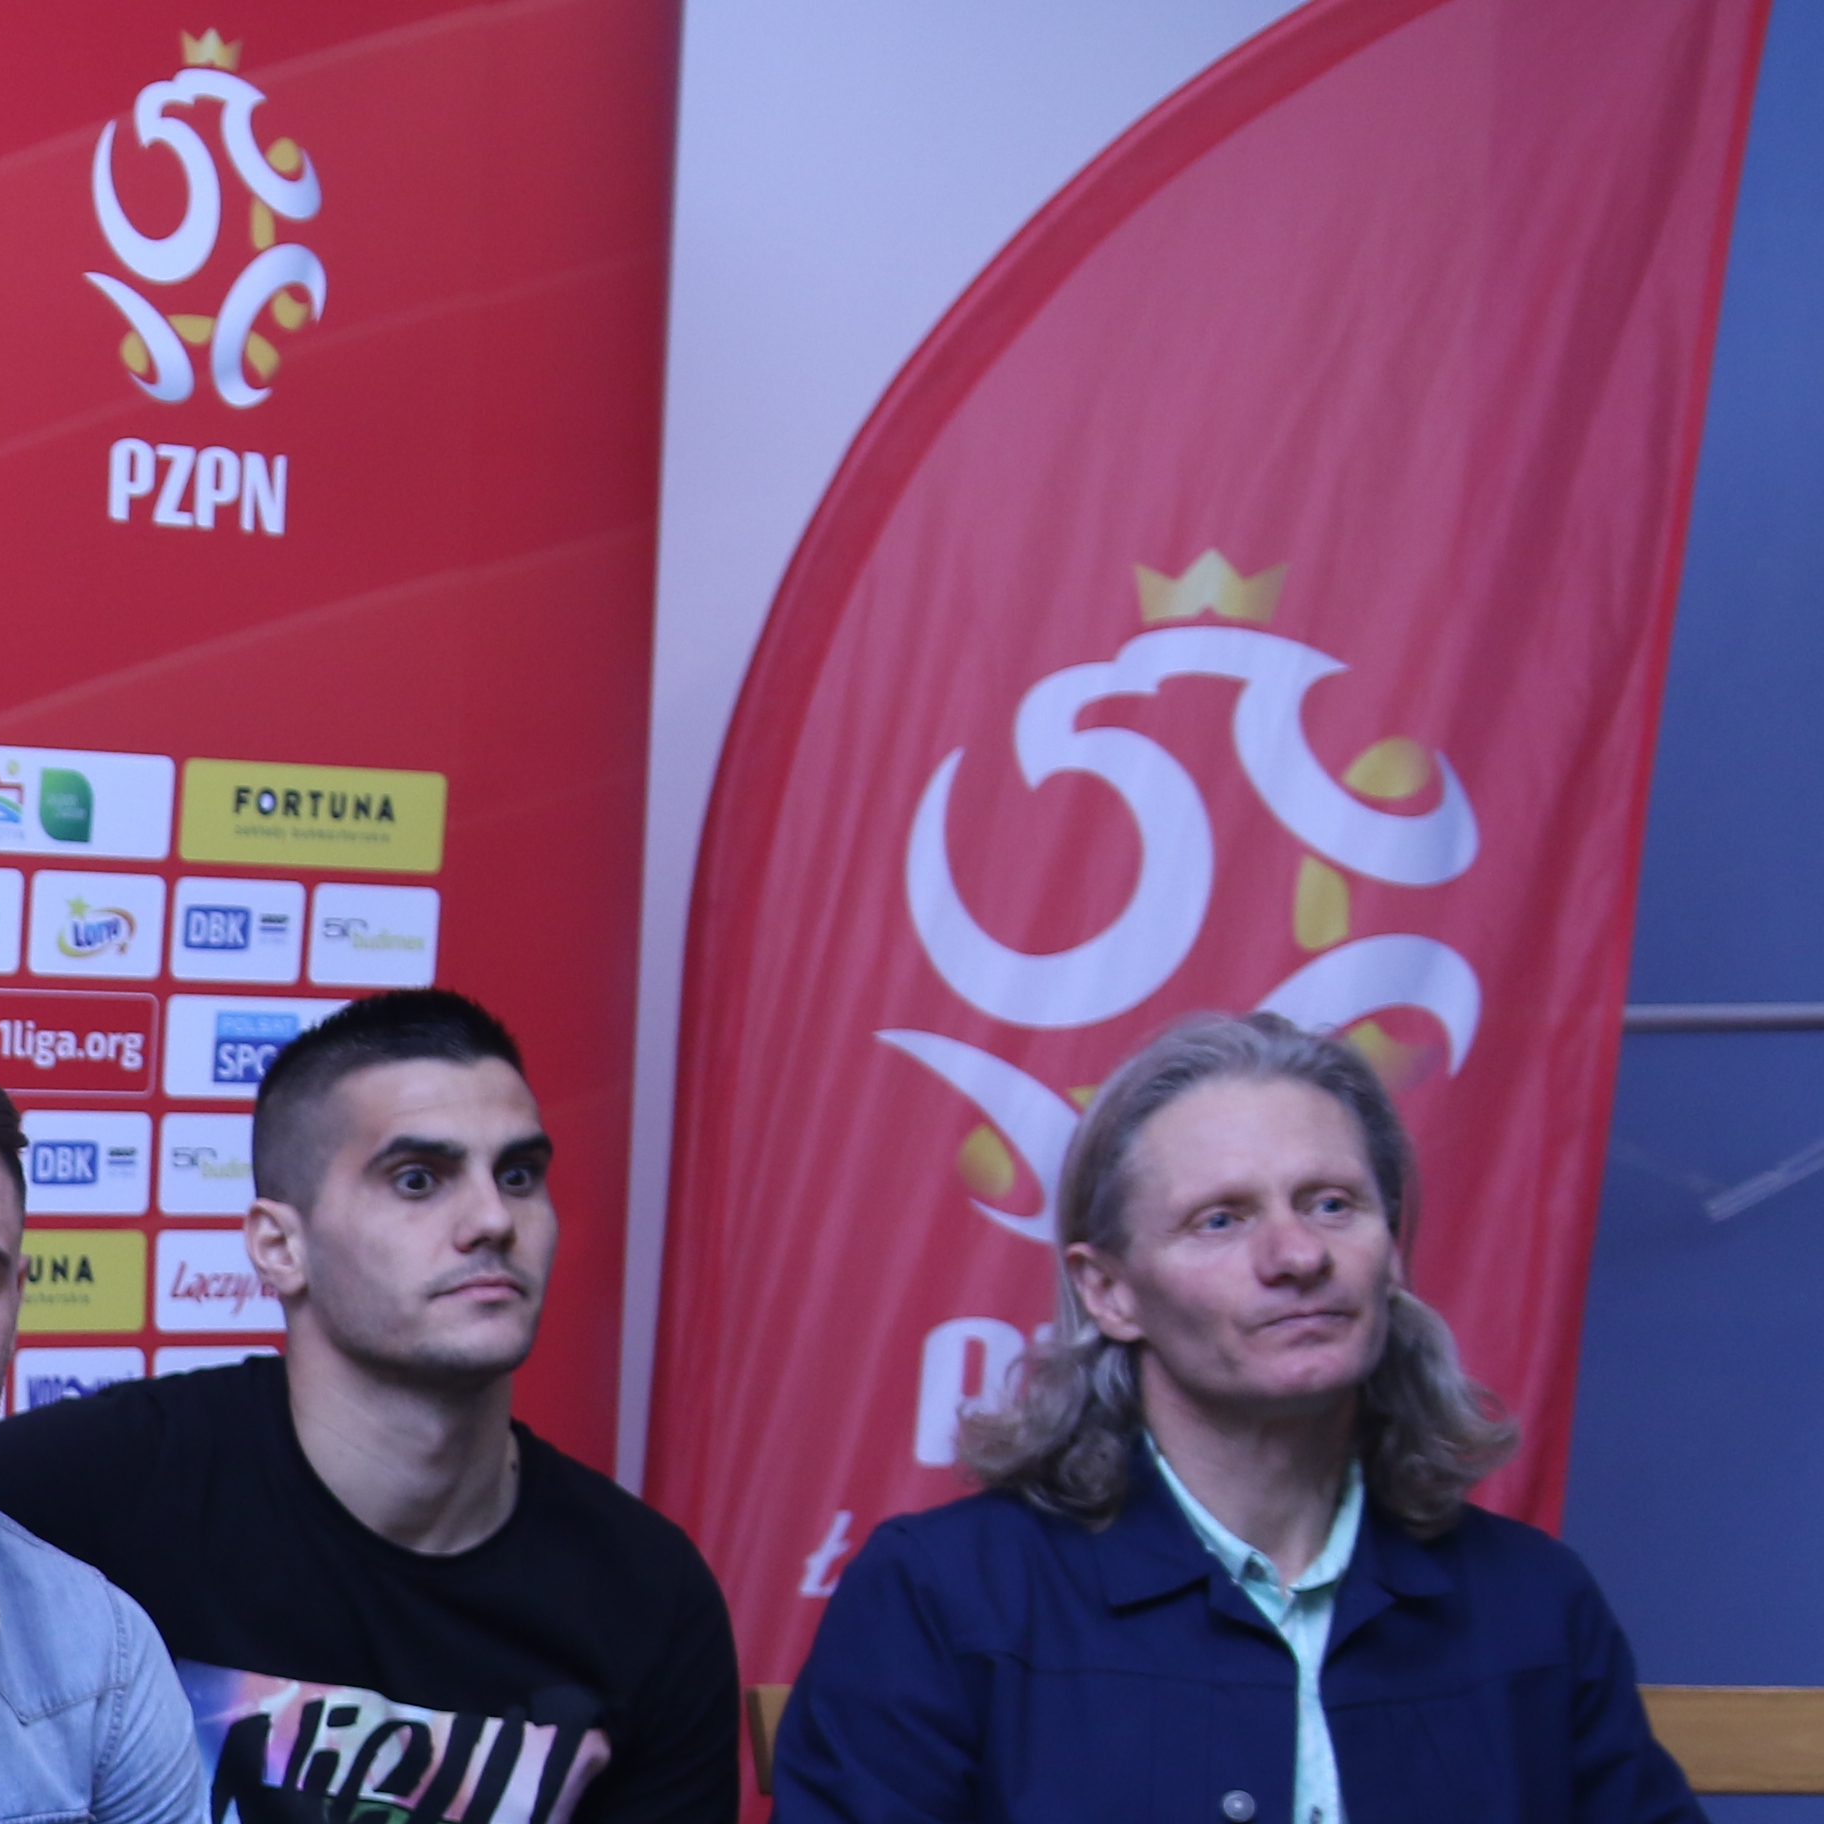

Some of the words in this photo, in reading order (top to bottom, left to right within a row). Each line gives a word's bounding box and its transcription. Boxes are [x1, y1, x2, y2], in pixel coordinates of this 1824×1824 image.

[108, 437, 287, 535] PZPN
[235, 786, 393, 822] FORTUNA
[189, 910, 243, 945] DBK
[36, 1146, 94, 1181] DBK
